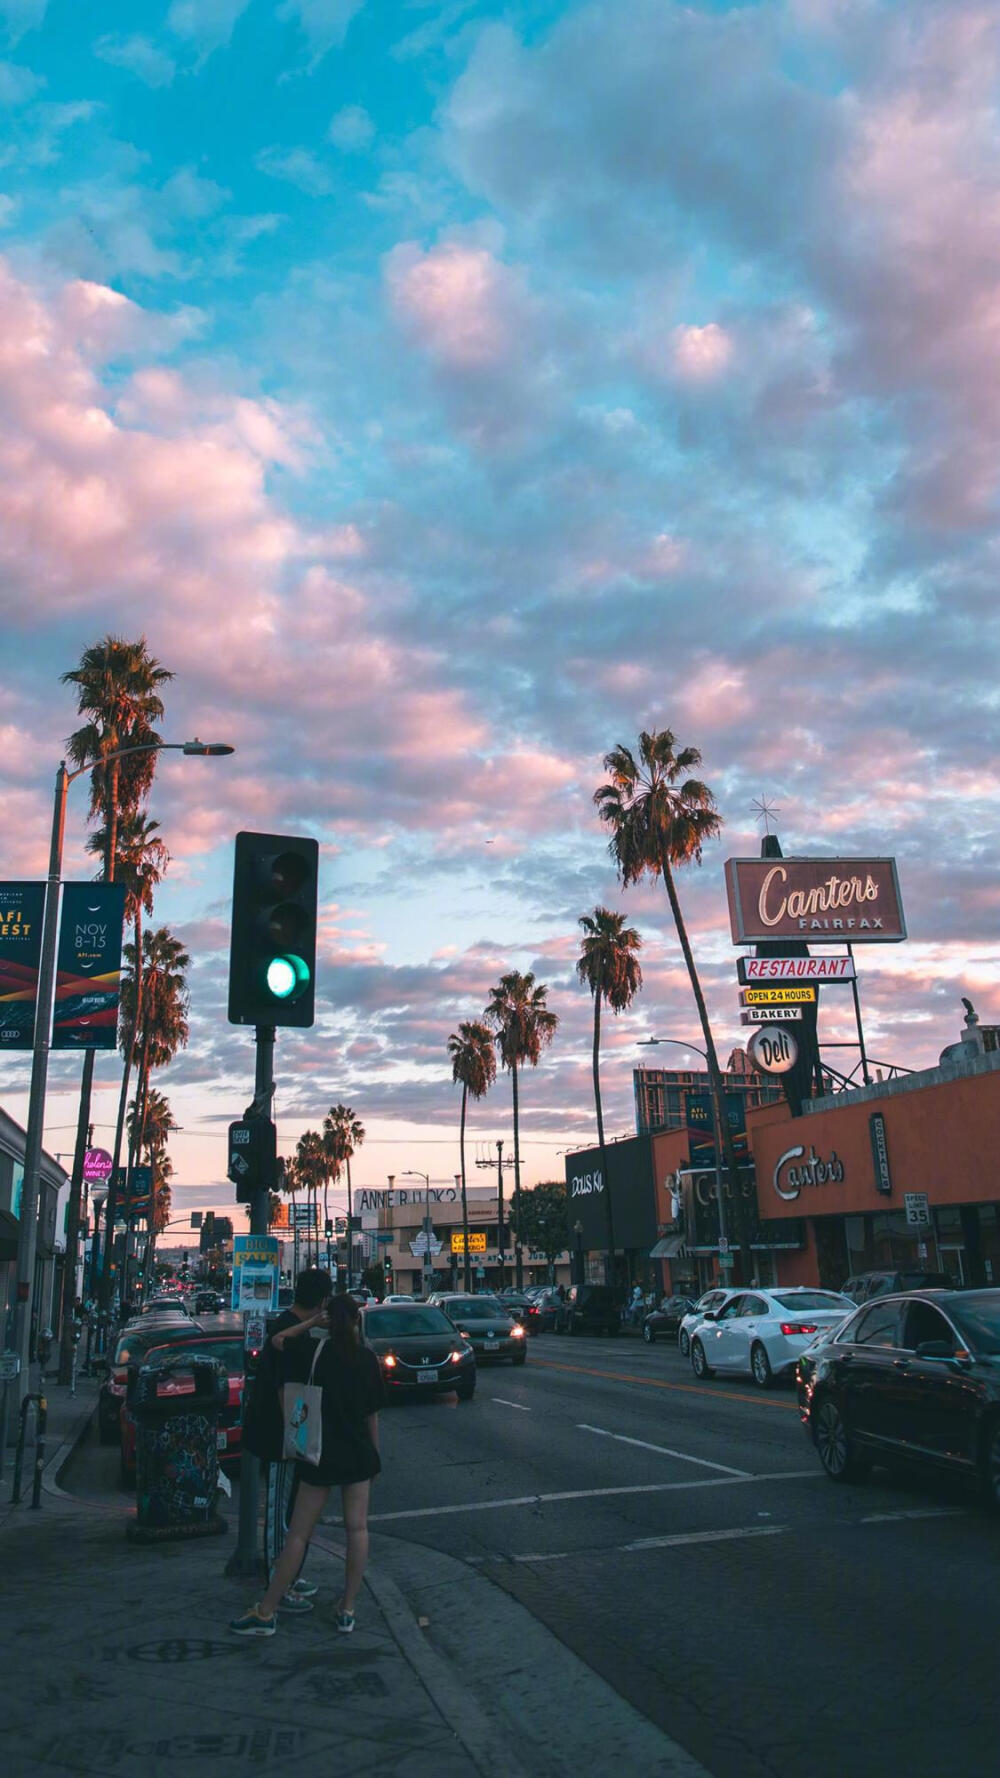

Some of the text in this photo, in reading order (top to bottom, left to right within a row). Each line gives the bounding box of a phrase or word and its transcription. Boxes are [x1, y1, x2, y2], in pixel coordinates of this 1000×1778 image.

[75, 923, 107, 936] NOV
[799, 918, 883, 930] FAIRFAX
[748, 959, 849, 977] RESTAURANT
[747, 990, 811, 1001] OPEN 24 HOURS
[751, 1009, 798, 1019] BAKERY
[759, 1031, 790, 1066] Deli
[360, 1190, 395, 1211] ANNIE
[909, 1210, 928, 1222] 35
